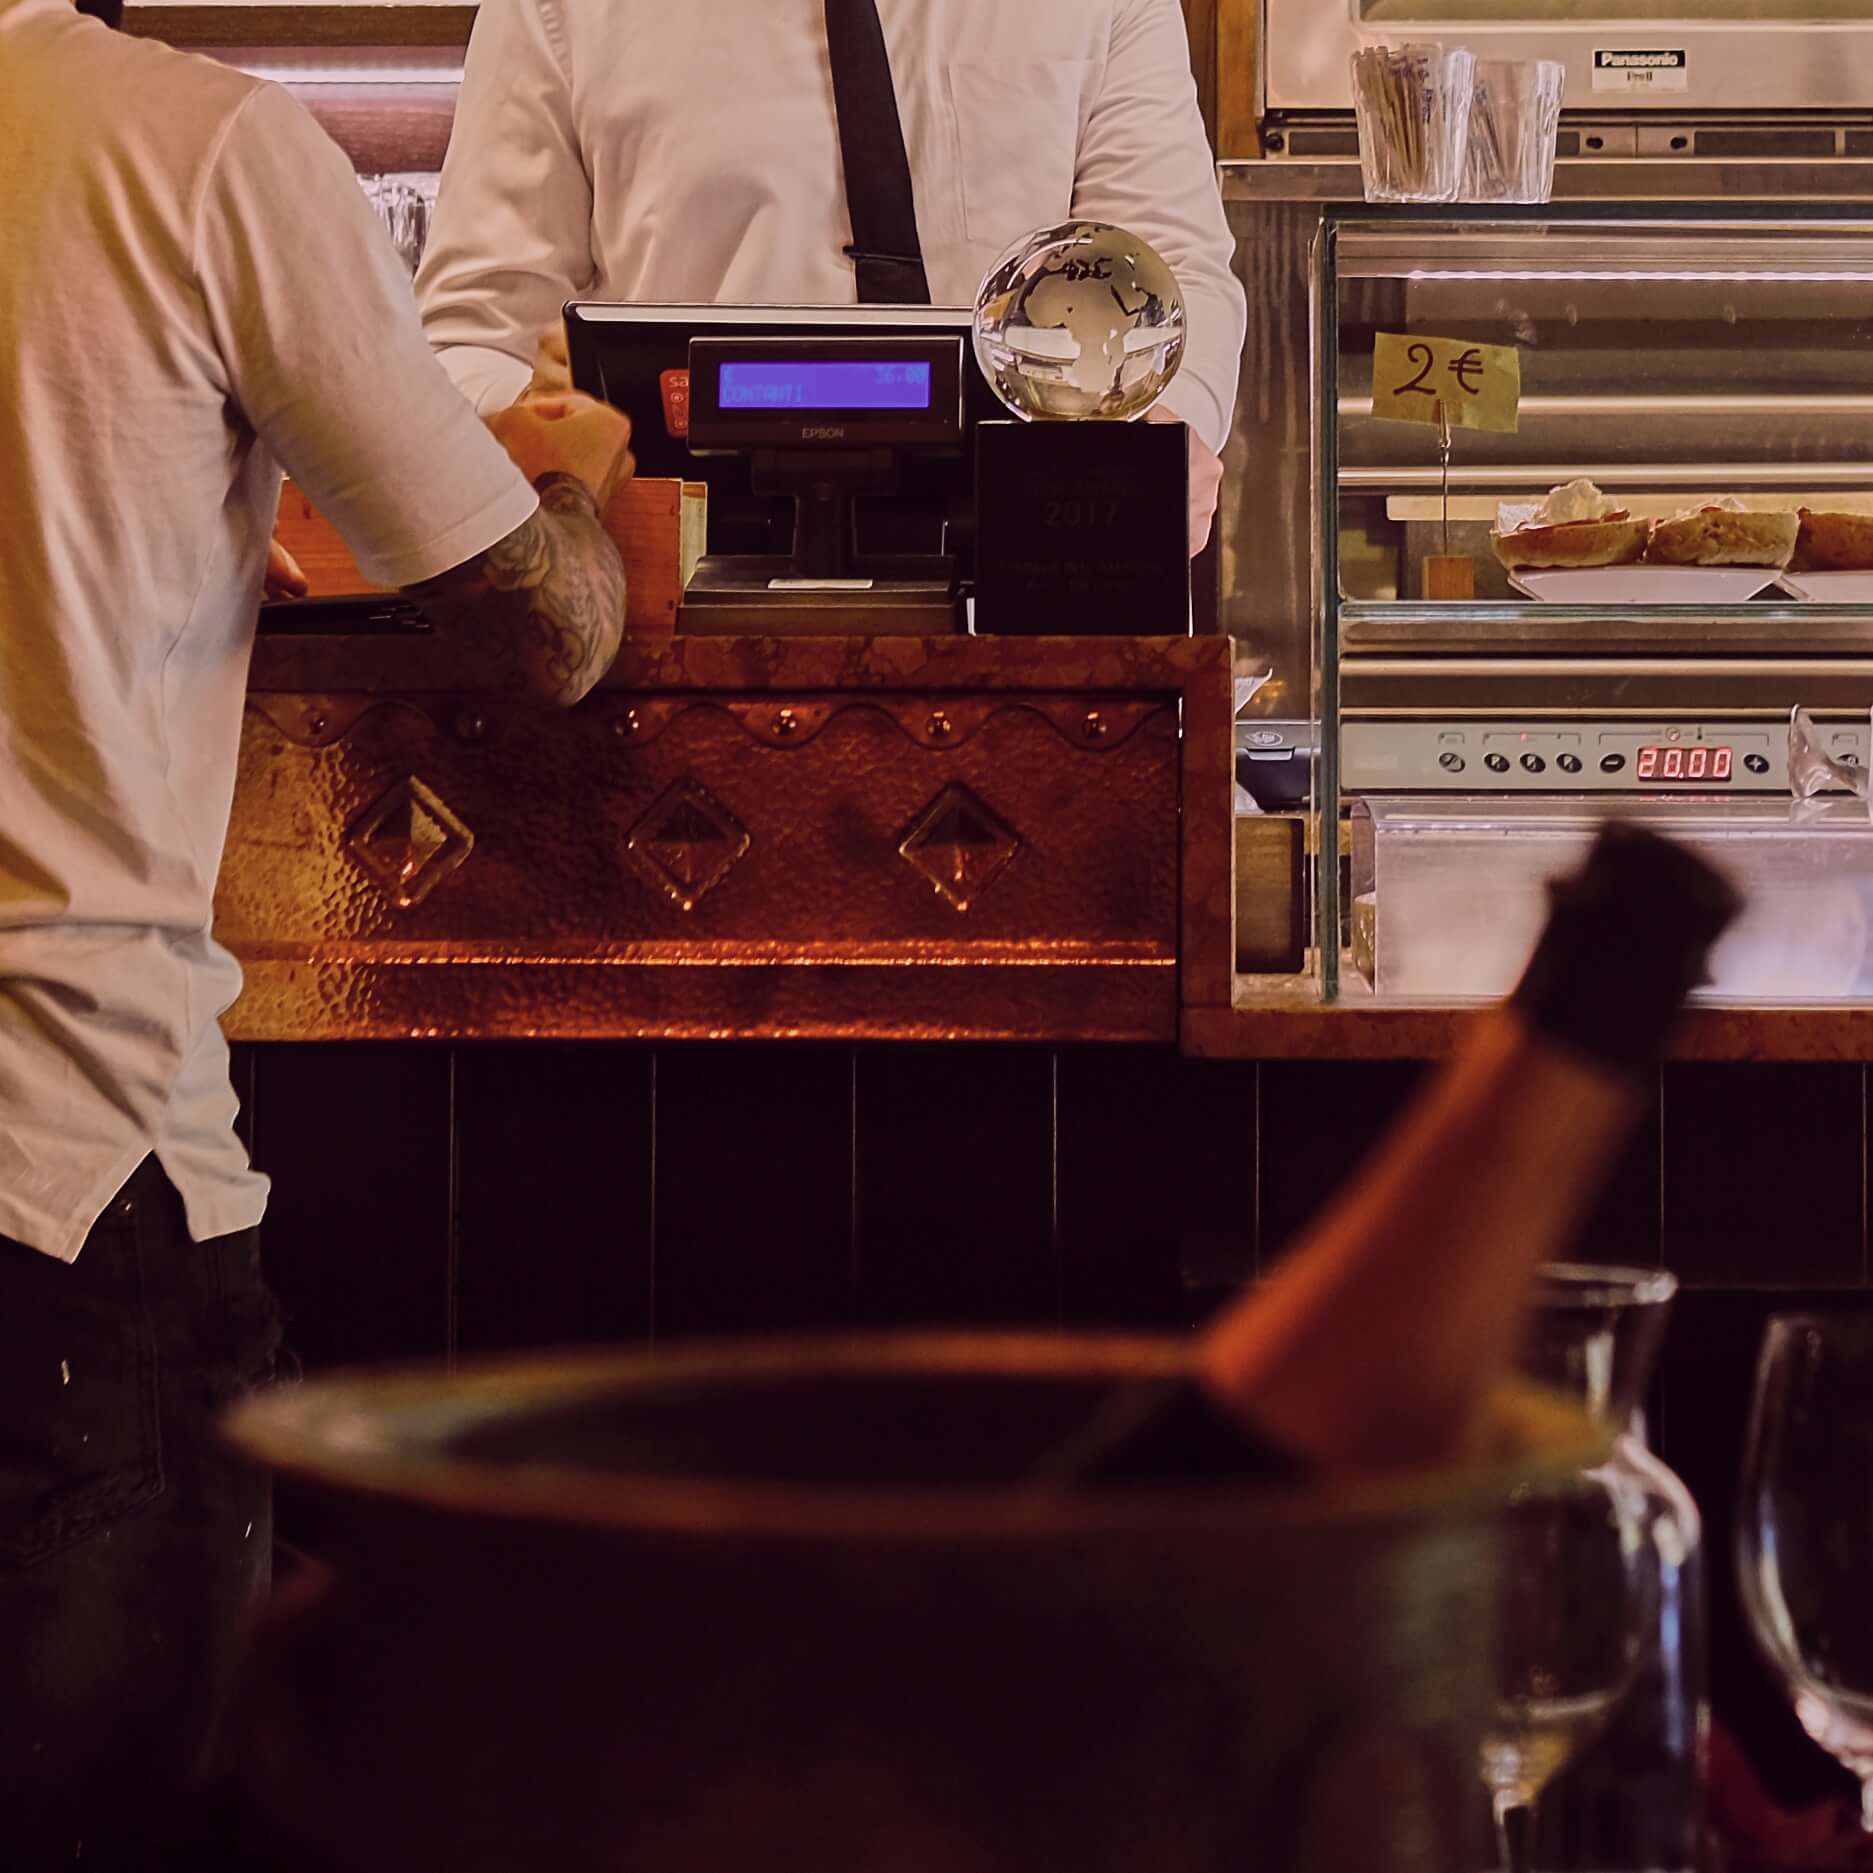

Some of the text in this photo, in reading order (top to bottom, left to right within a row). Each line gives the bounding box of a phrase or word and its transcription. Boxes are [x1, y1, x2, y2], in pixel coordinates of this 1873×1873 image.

[1601, 52, 1678, 66] Panasonic
[1392, 344, 1484, 395] 2 €
[802, 428, 844, 439] EPSON
[1638, 747, 1732, 780] 20.00
